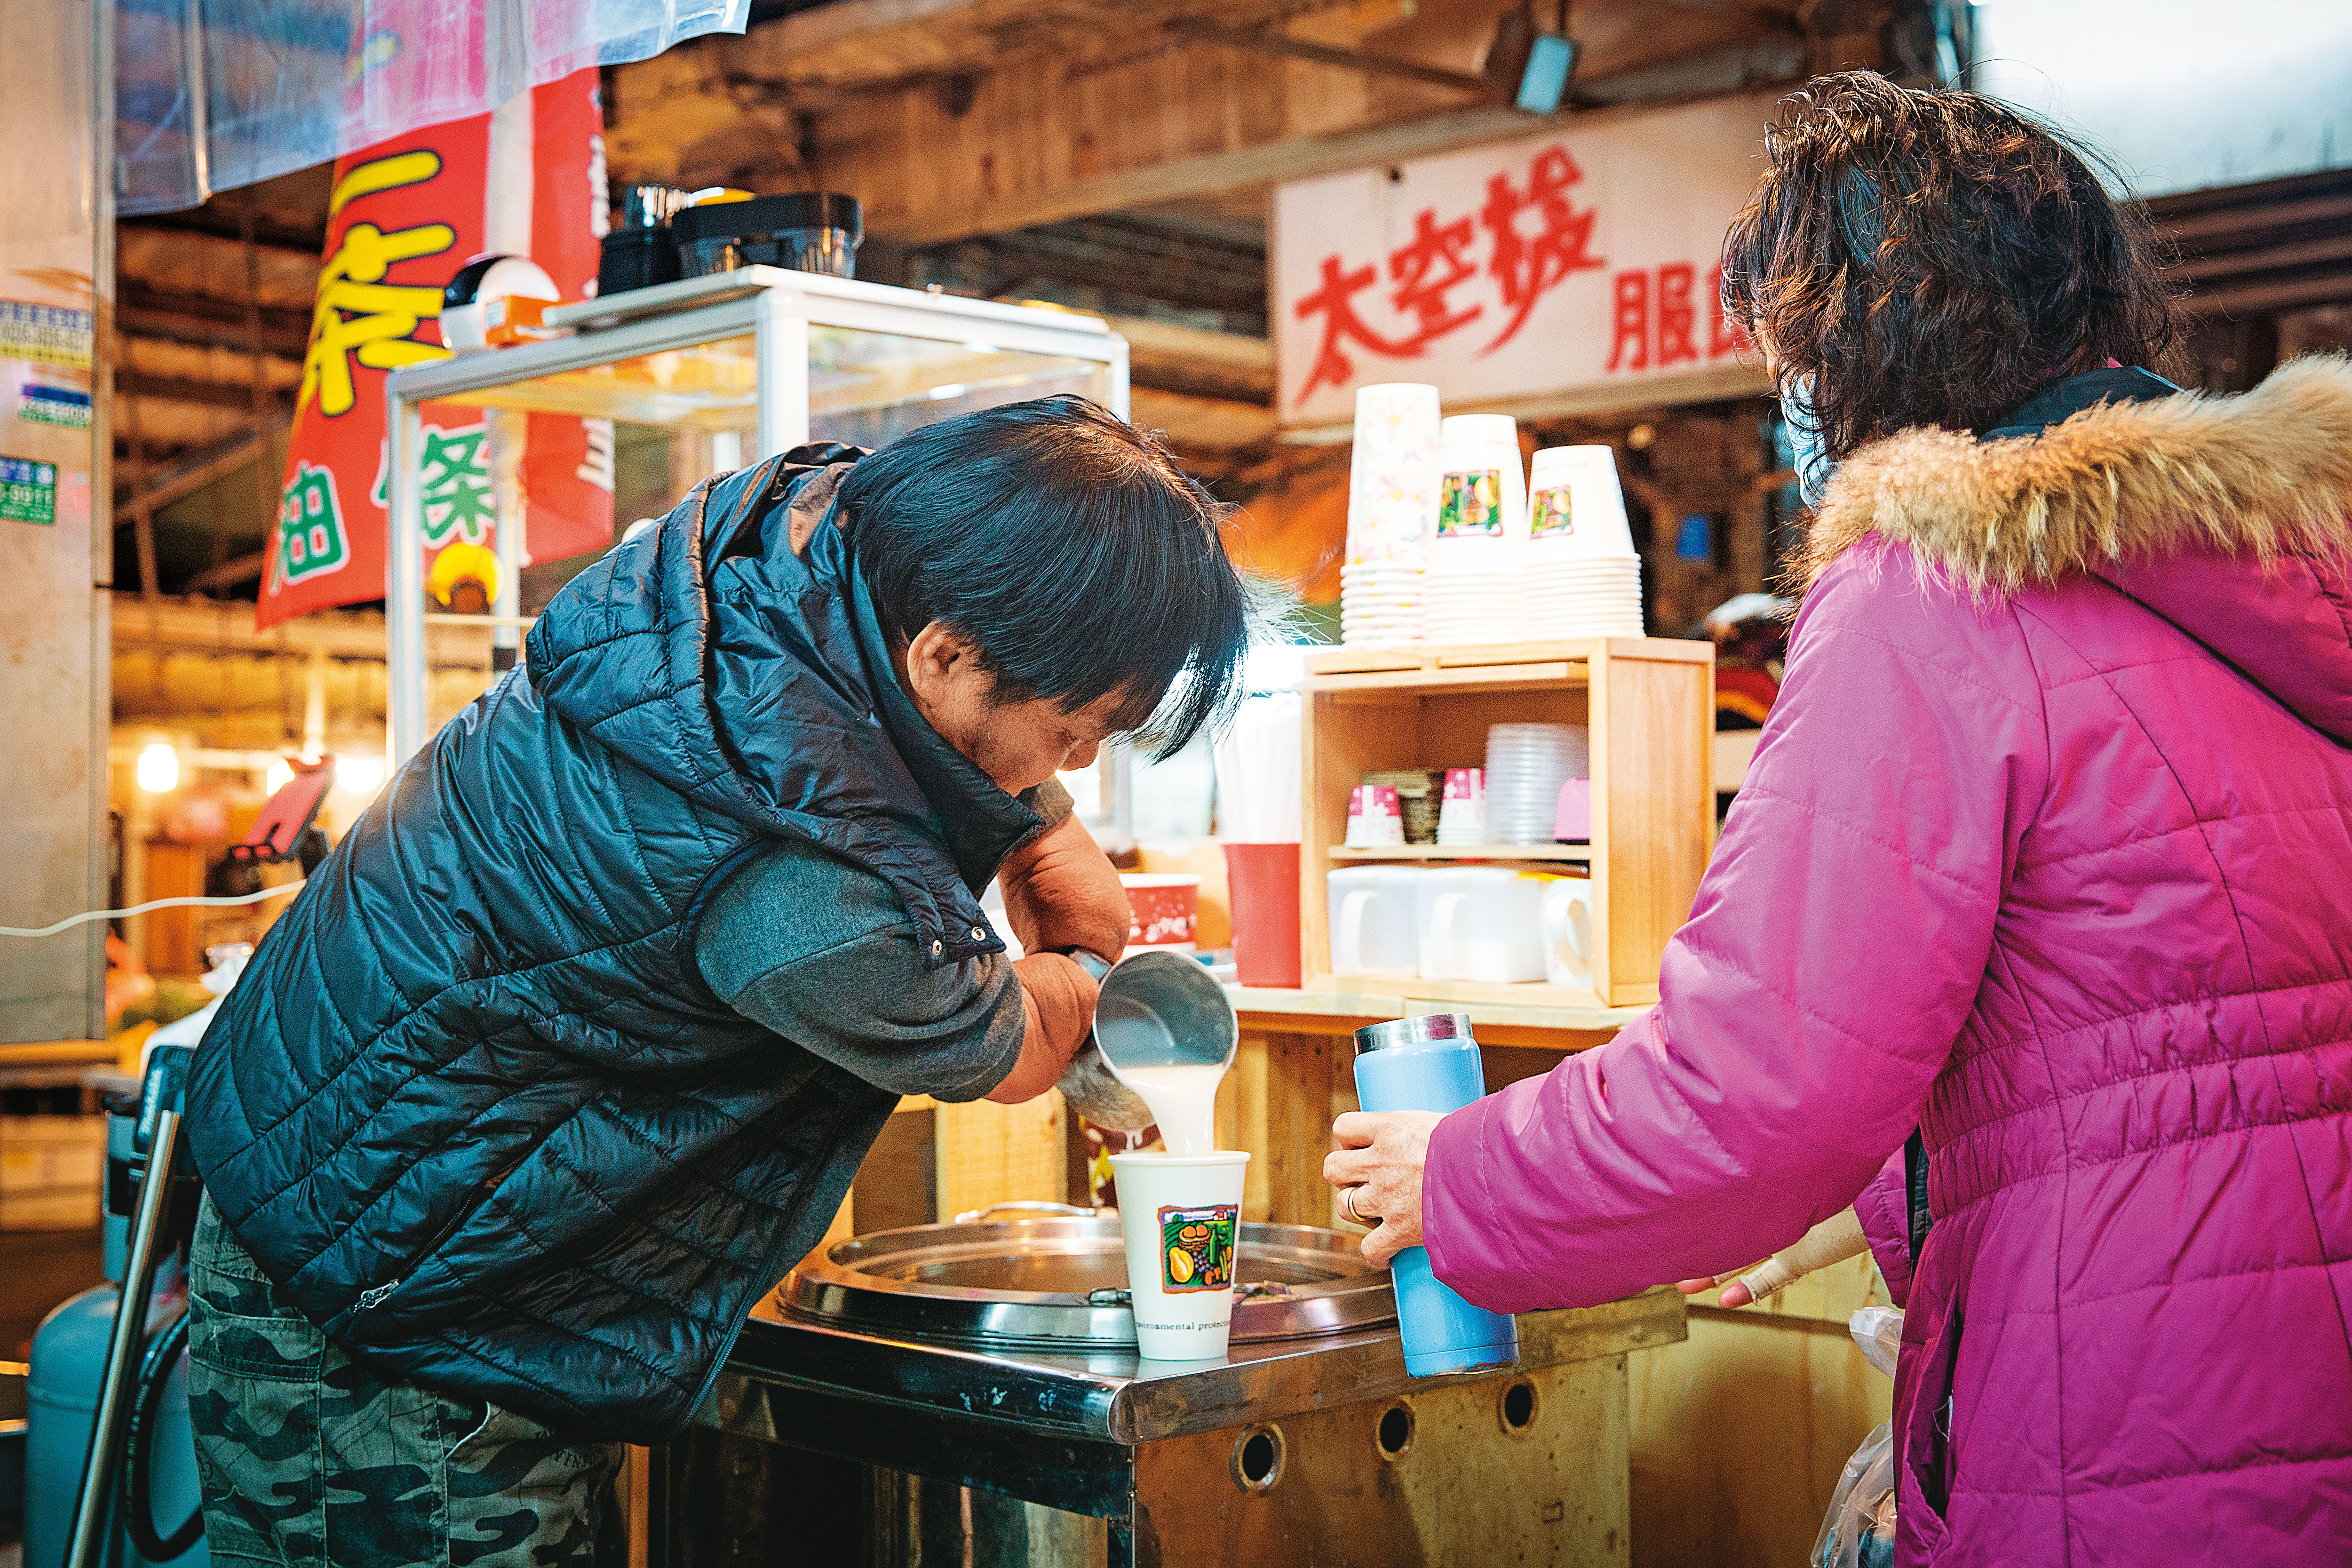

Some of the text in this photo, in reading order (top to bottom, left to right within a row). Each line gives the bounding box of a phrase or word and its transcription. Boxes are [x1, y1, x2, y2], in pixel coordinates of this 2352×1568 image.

[1295, 145, 1605, 407] 太空梭
[1136, 1321, 1194, 1330] nvironmental
